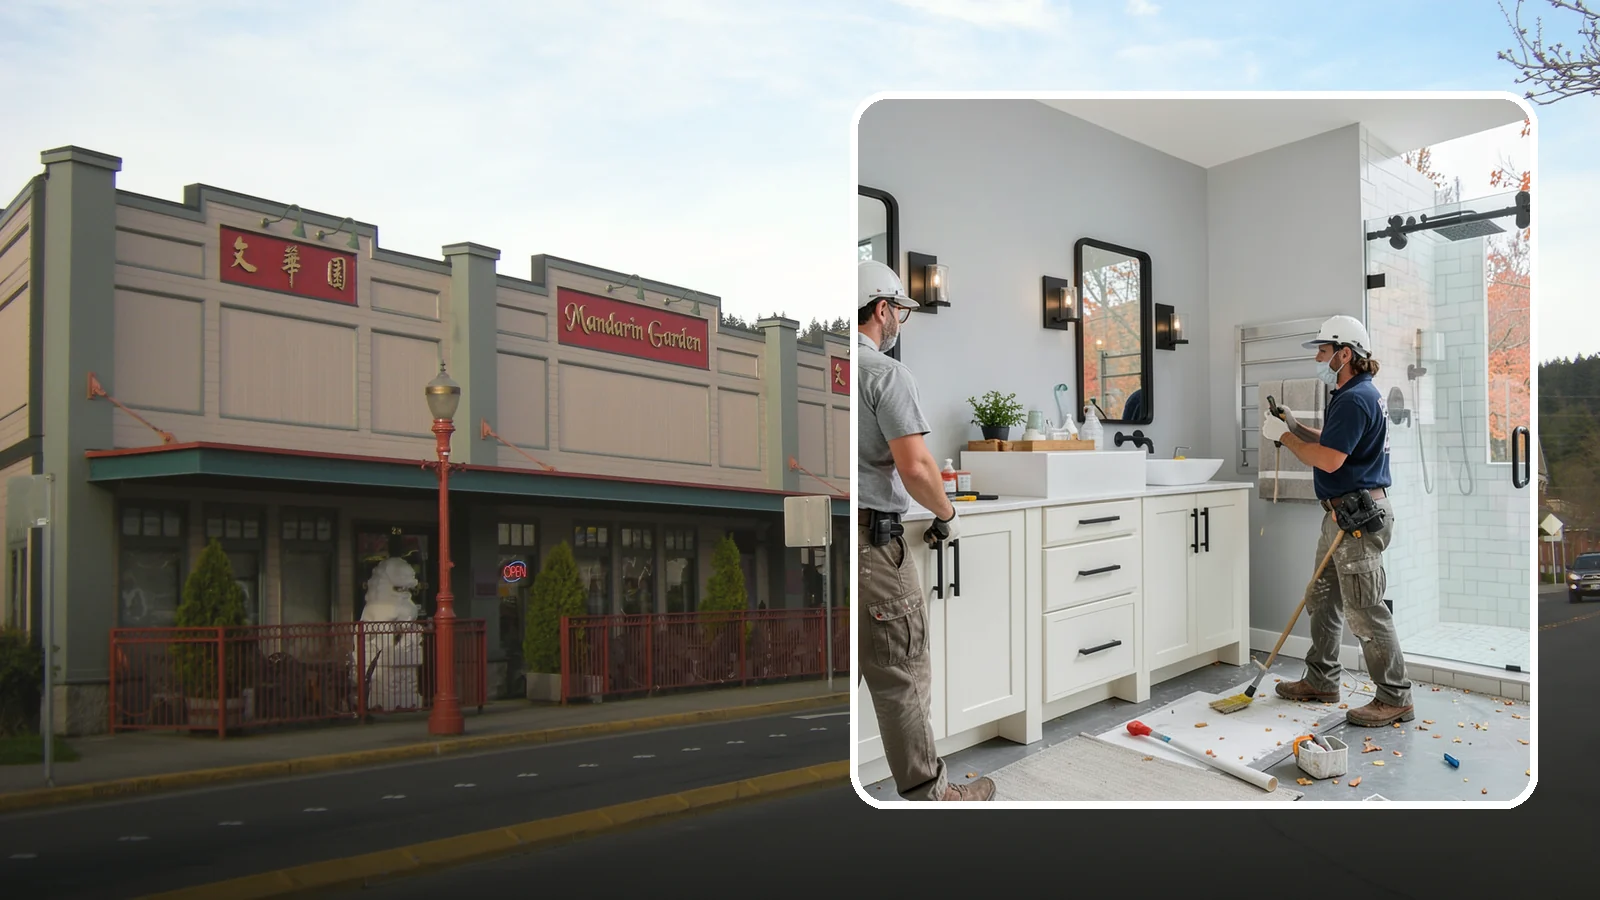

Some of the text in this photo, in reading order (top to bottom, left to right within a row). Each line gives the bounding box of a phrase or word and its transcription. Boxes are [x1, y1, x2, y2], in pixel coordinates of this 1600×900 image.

[231, 236, 346, 290] 文華園
[564, 303, 701, 352] Mandarin Garden
[503, 566, 527, 577] OPEN
